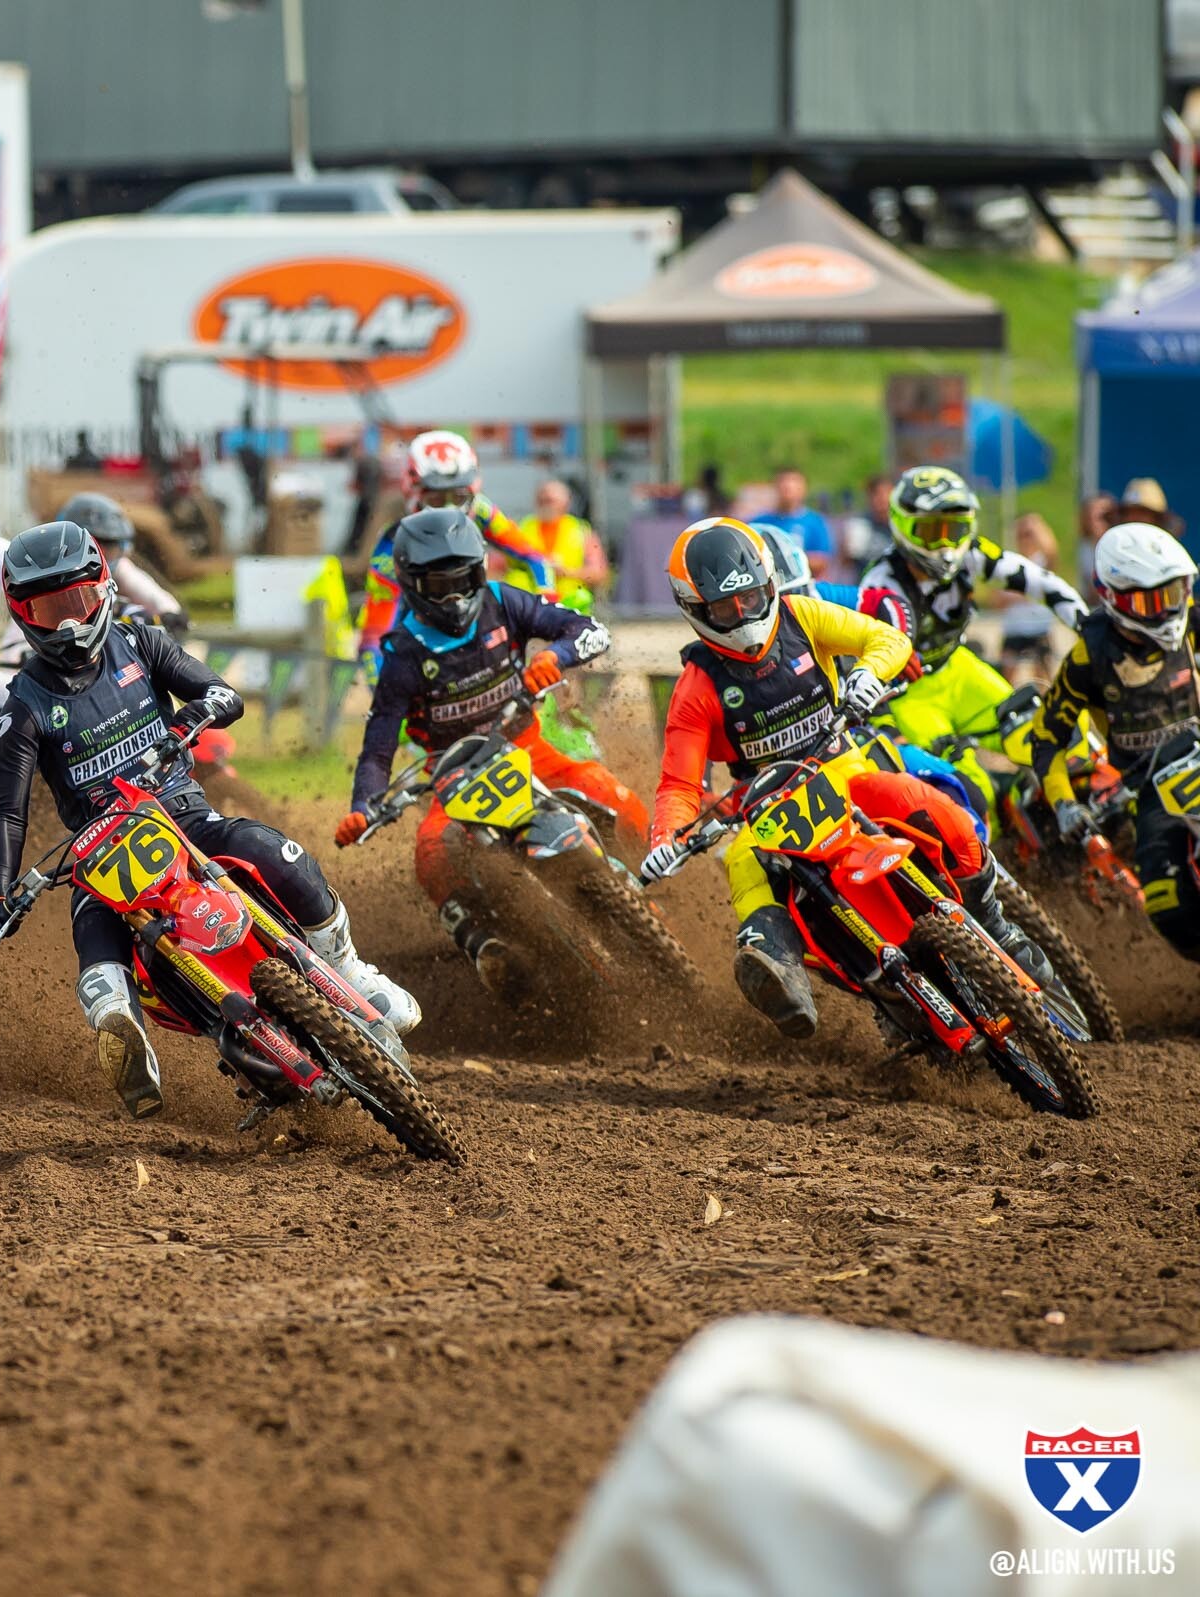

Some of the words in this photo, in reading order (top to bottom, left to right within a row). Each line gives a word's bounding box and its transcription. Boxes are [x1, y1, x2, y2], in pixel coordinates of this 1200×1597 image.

[92, 708, 131, 734] MONSTER
[765, 694, 804, 717] MONSTER
[71, 720, 164, 783] CHAMPIONSHIP
[96, 729, 126, 750] NATIONAL
[745, 706, 830, 757] CHAMPIONSHIP
[461, 761, 527, 819] 36
[769, 771, 847, 852] 34
[77, 805, 124, 852] RENTHAL
[97, 822, 175, 904] 76
[182, 954, 225, 994] Factory
